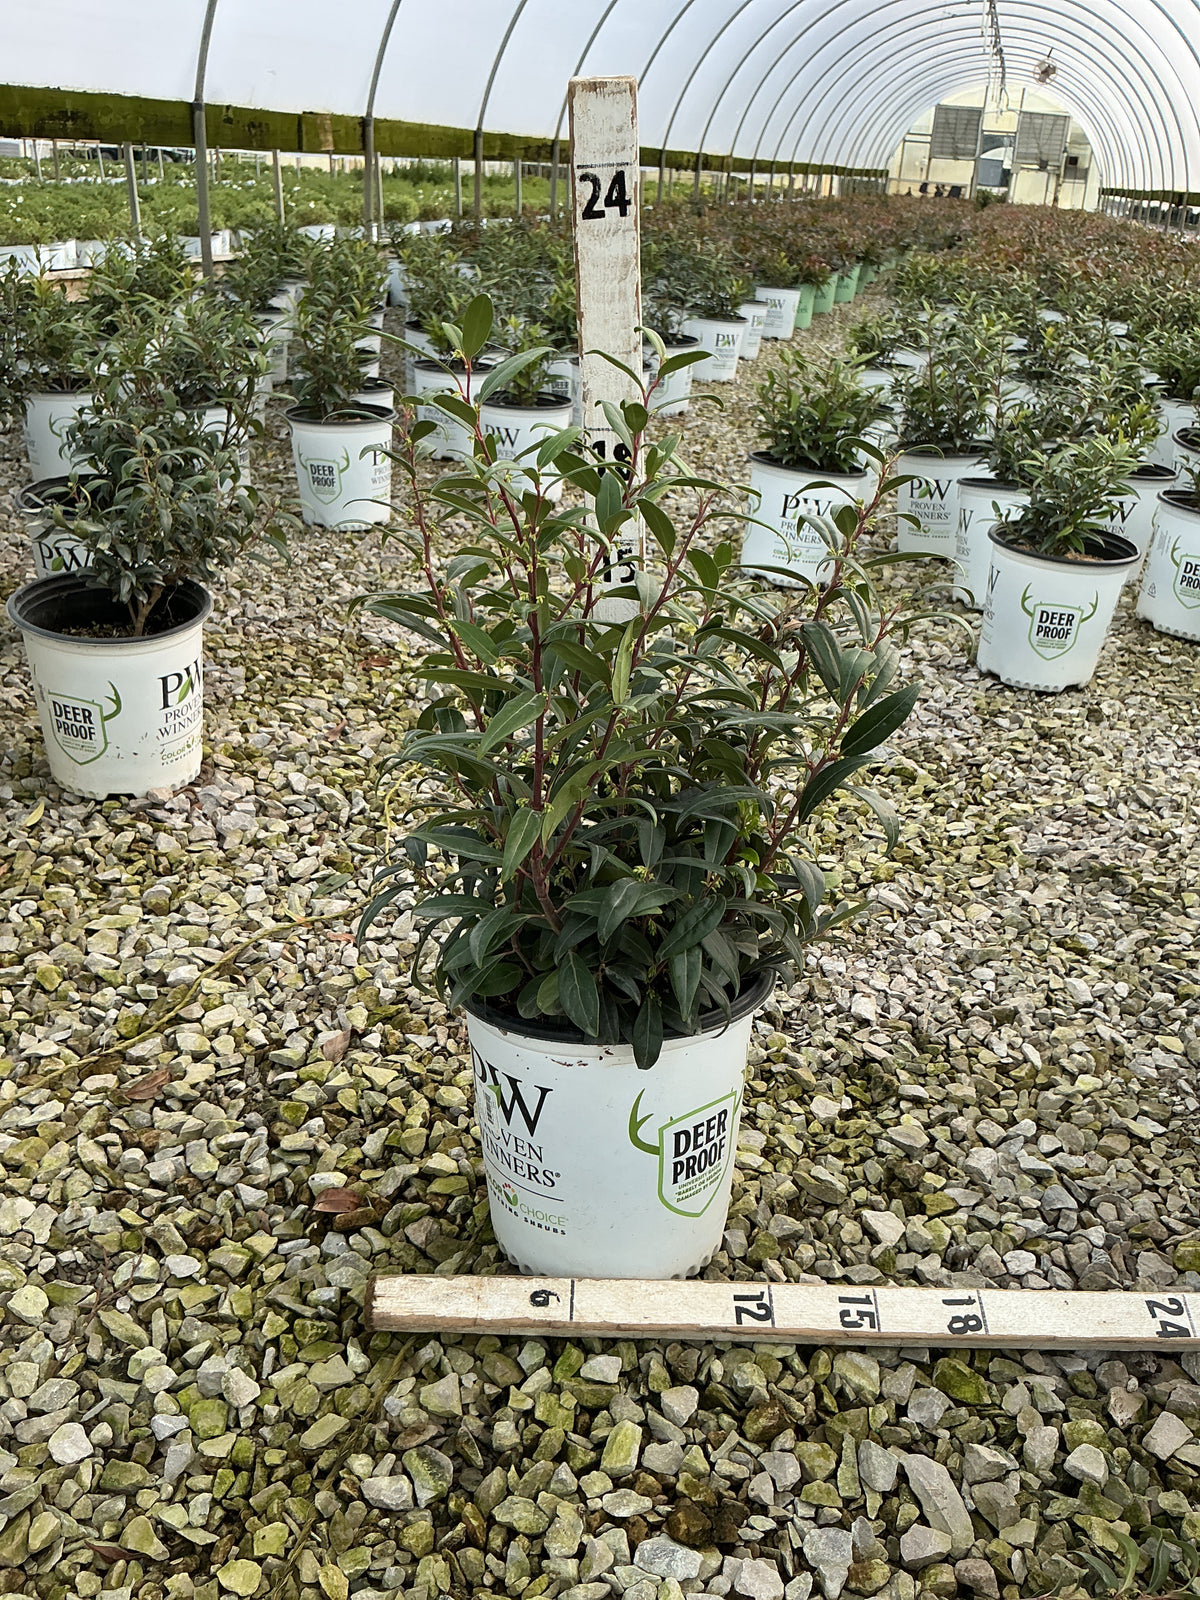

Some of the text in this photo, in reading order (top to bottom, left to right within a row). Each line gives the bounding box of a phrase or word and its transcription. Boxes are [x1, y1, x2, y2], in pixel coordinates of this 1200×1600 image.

[579, 170, 632, 220] 24
[310, 463, 335, 477] DEER
[592, 440, 633, 481] 18
[312, 476, 336, 488] PROOF
[909, 478, 952, 501] PW
[910, 500, 946, 511] PROVEN
[38, 541, 94, 572] PW
[603, 548, 636, 584] 15
[1039, 610, 1075, 627] DEER
[1036, 625, 1072, 640] PROOF
[52, 700, 94, 725] DEER
[55, 718, 96, 741] PROOF
[161, 746, 186, 761] COLOR
[673, 1108, 728, 1159] DEER
[672, 1135, 726, 1185] PROOF
[677, 1187, 703, 1203] DAMAGED
[519, 1203, 566, 1227] CHOICE
[524, 1217, 566, 1235] SHRUBS
[530, 1289, 1191, 1338] 6 12 15 18 24
